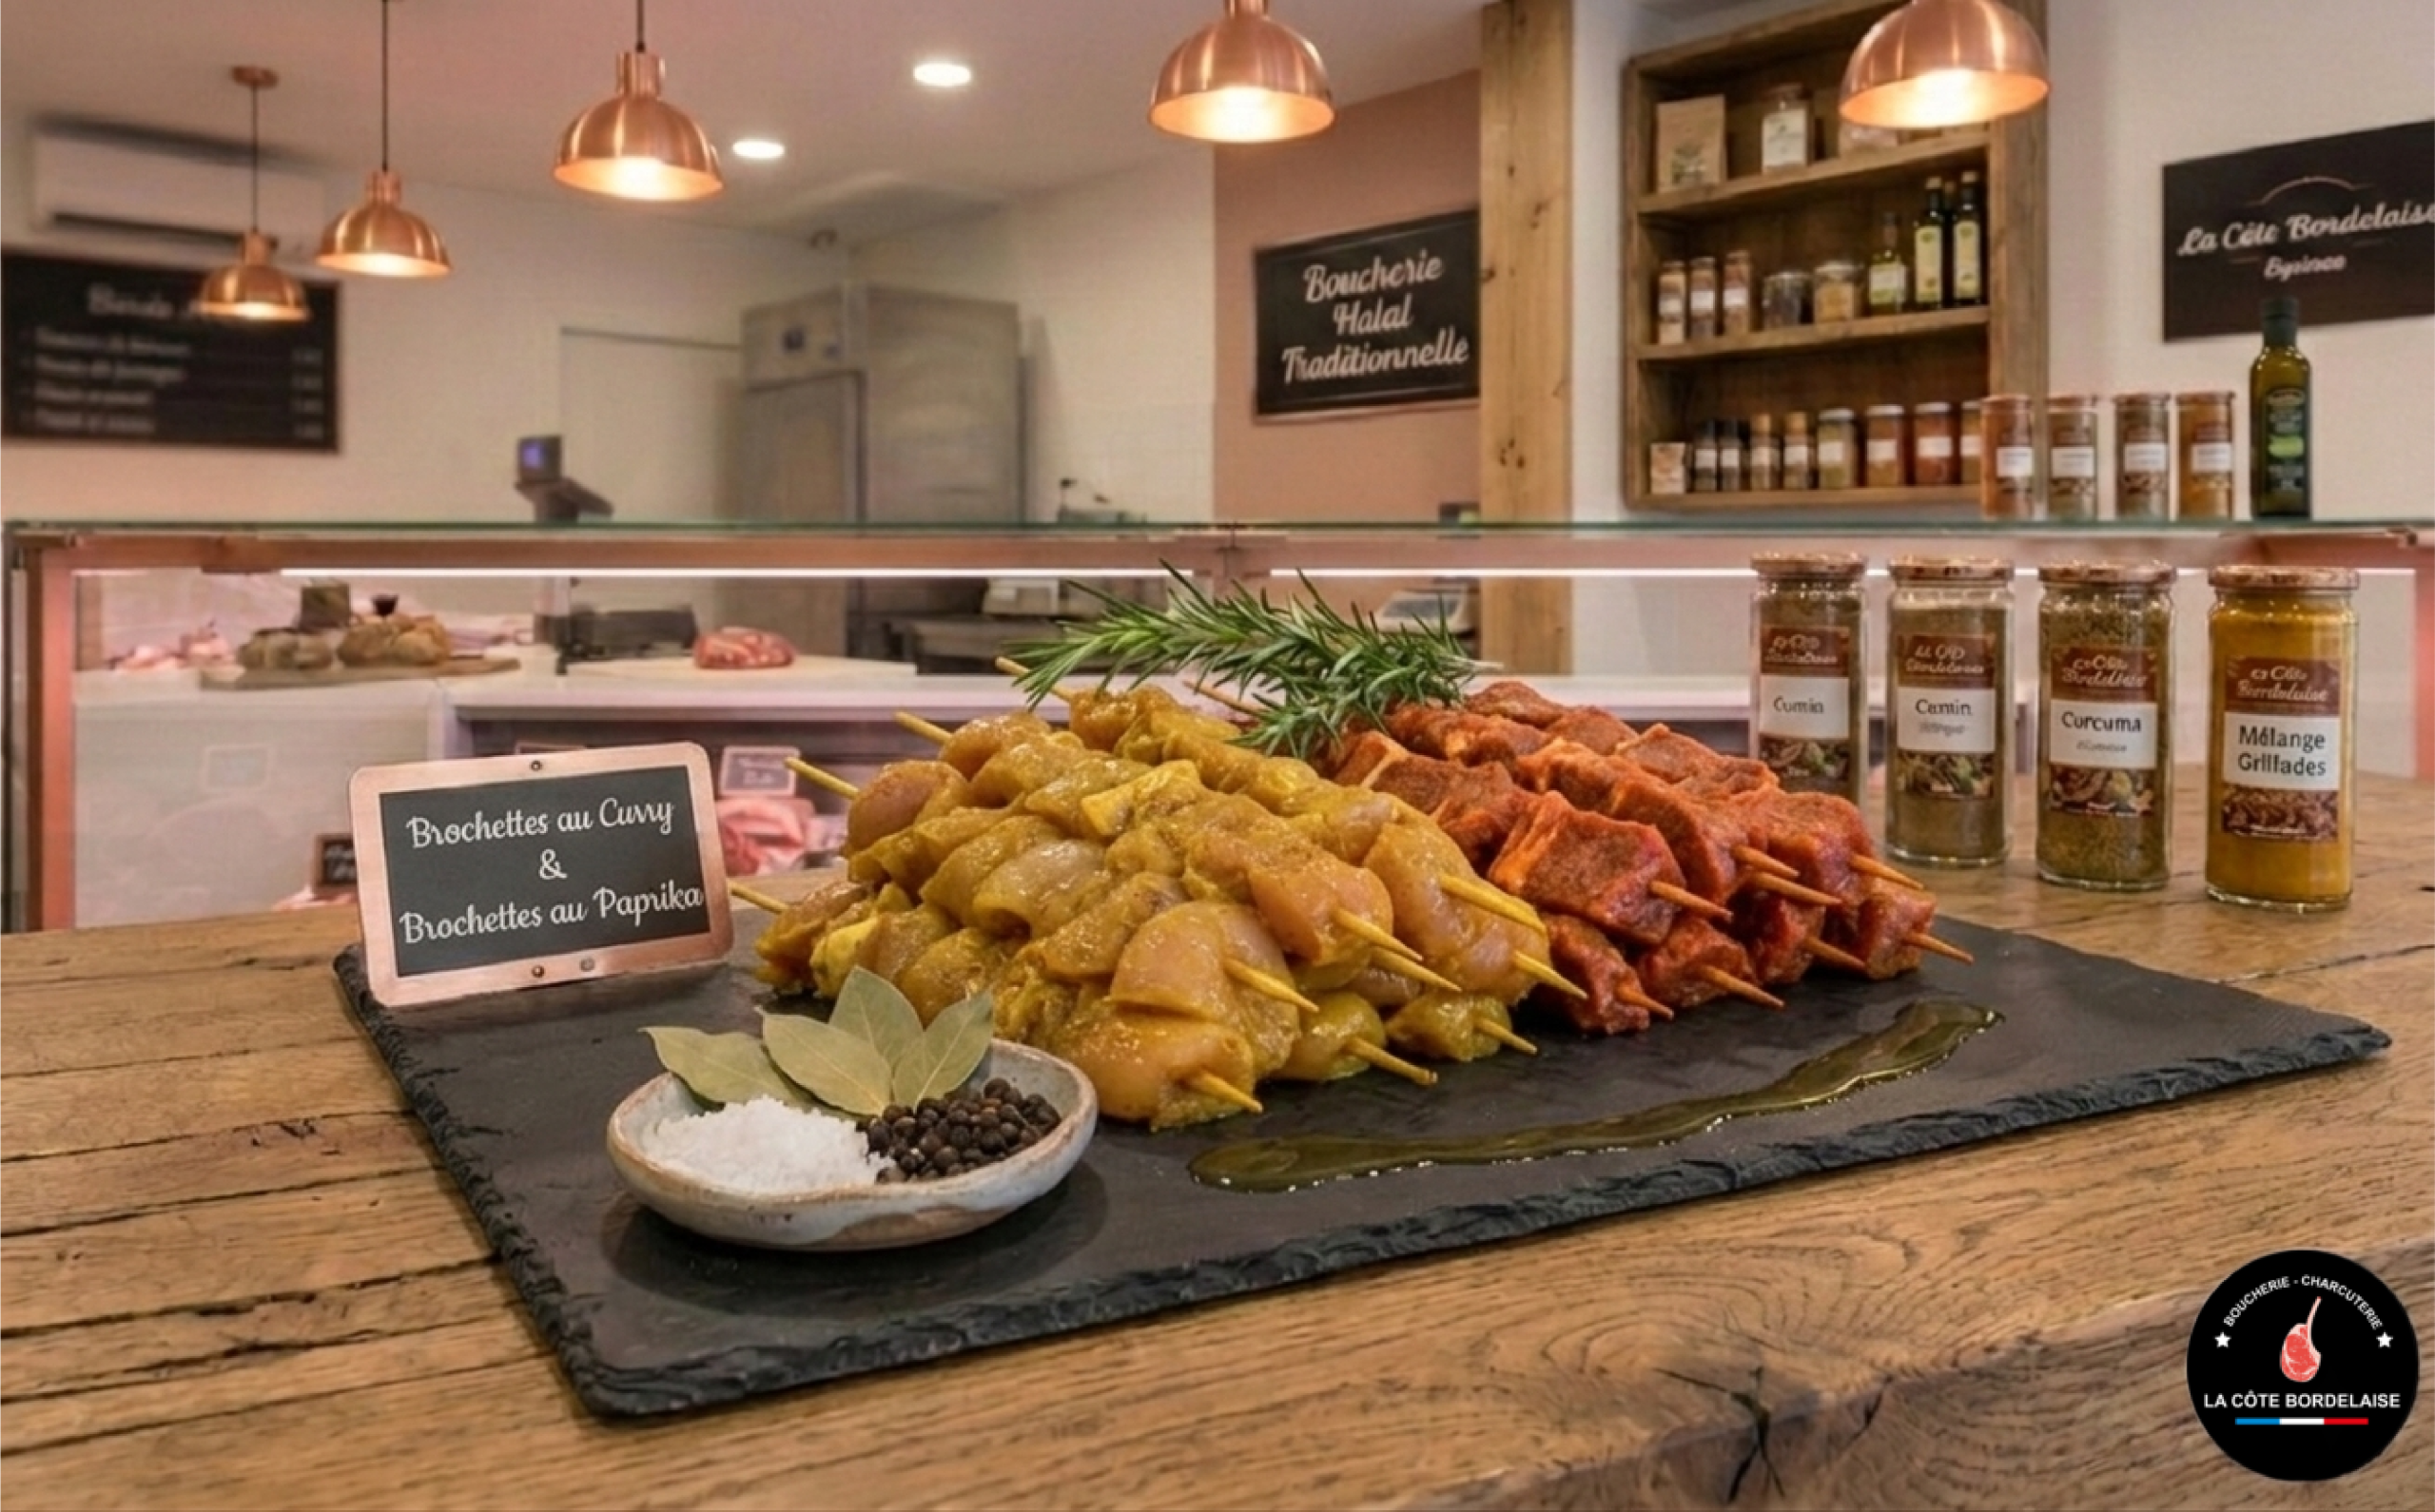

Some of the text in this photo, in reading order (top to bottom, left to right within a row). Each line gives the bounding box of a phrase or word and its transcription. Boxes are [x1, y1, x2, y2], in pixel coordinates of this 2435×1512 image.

[1303, 248, 1444, 303] Boucherie
[1334, 292, 1413, 336] Halal
[1281, 325, 1470, 385] Traditionnelle
[2061, 710, 2142, 732] Curcuma
[2238, 725, 2326, 753] Mélange
[2237, 751, 2327, 776] Grillades
[405, 798, 674, 848] Brochettes au Curry
[538, 849, 567, 880] &
[399, 880, 705, 943] Brochettes au Paprika
